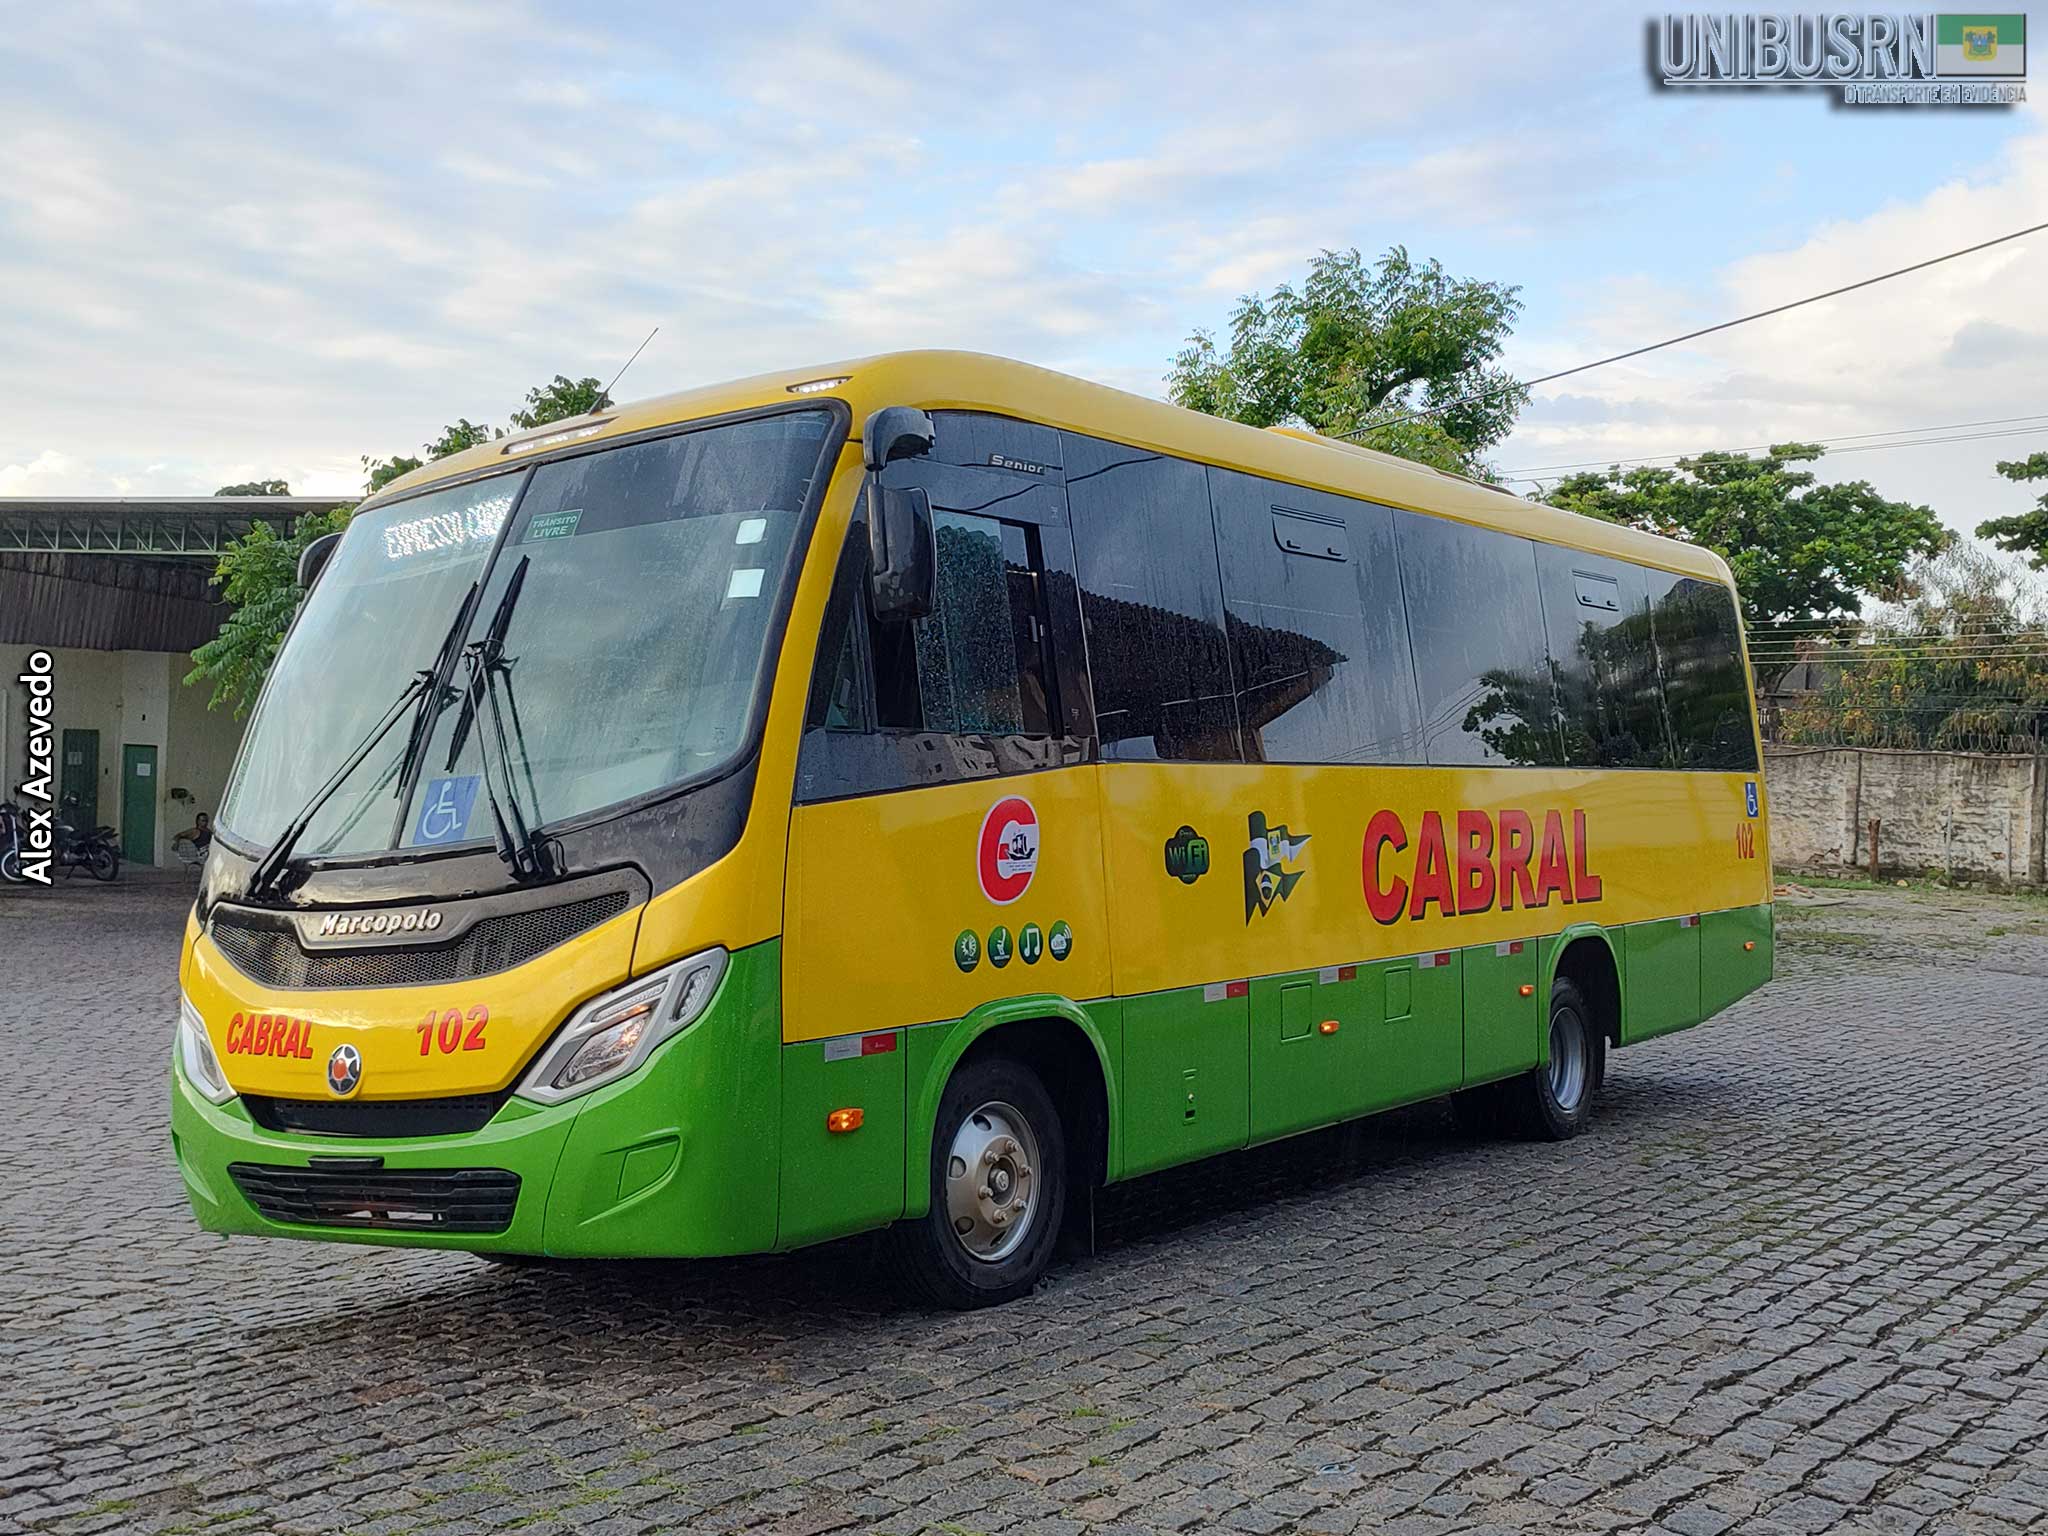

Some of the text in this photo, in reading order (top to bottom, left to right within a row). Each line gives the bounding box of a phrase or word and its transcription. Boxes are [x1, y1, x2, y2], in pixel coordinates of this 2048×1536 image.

[991, 454, 1043, 473] Senior
[533, 525, 569, 538] LIVRE
[1736, 822, 1755, 859] 102
[1362, 808, 1602, 926] CABRAL
[319, 908, 443, 936] Marcopolo
[226, 1004, 489, 1059] CABRAL 102
